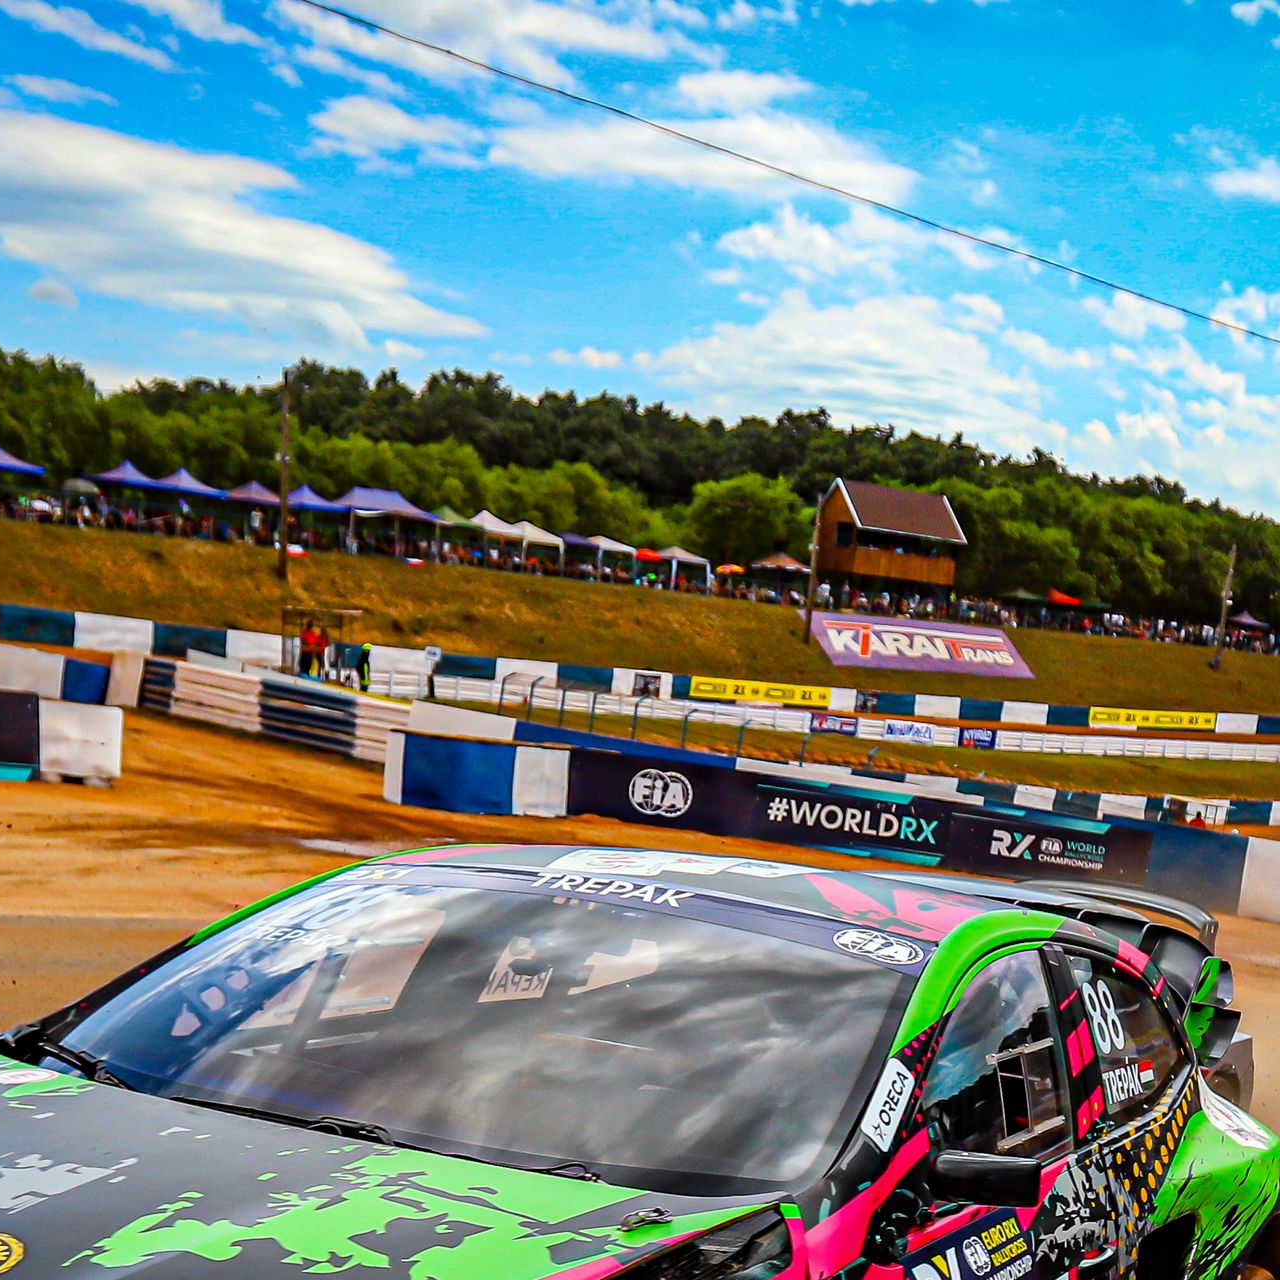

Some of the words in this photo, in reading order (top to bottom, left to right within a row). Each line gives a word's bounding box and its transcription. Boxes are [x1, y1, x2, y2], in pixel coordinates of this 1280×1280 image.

[632, 776, 691, 810] FIA
[767, 796, 938, 845] #WORLDRX
[989, 829, 1037, 861] RX
[1040, 838, 1063, 853] FIA
[1066, 840, 1106, 856] WORLD
[1038, 854, 1104, 871] CHAMPIONSHIP
[836, 930, 913, 963] FIA
[1080, 978, 1126, 1055] 88
[1101, 1056, 1144, 1105] TREPÁK
[878, 1070, 910, 1127] ORECA
[981, 1224, 1006, 1251] EURO
[990, 1237, 1028, 1268] RALLYCROSS
